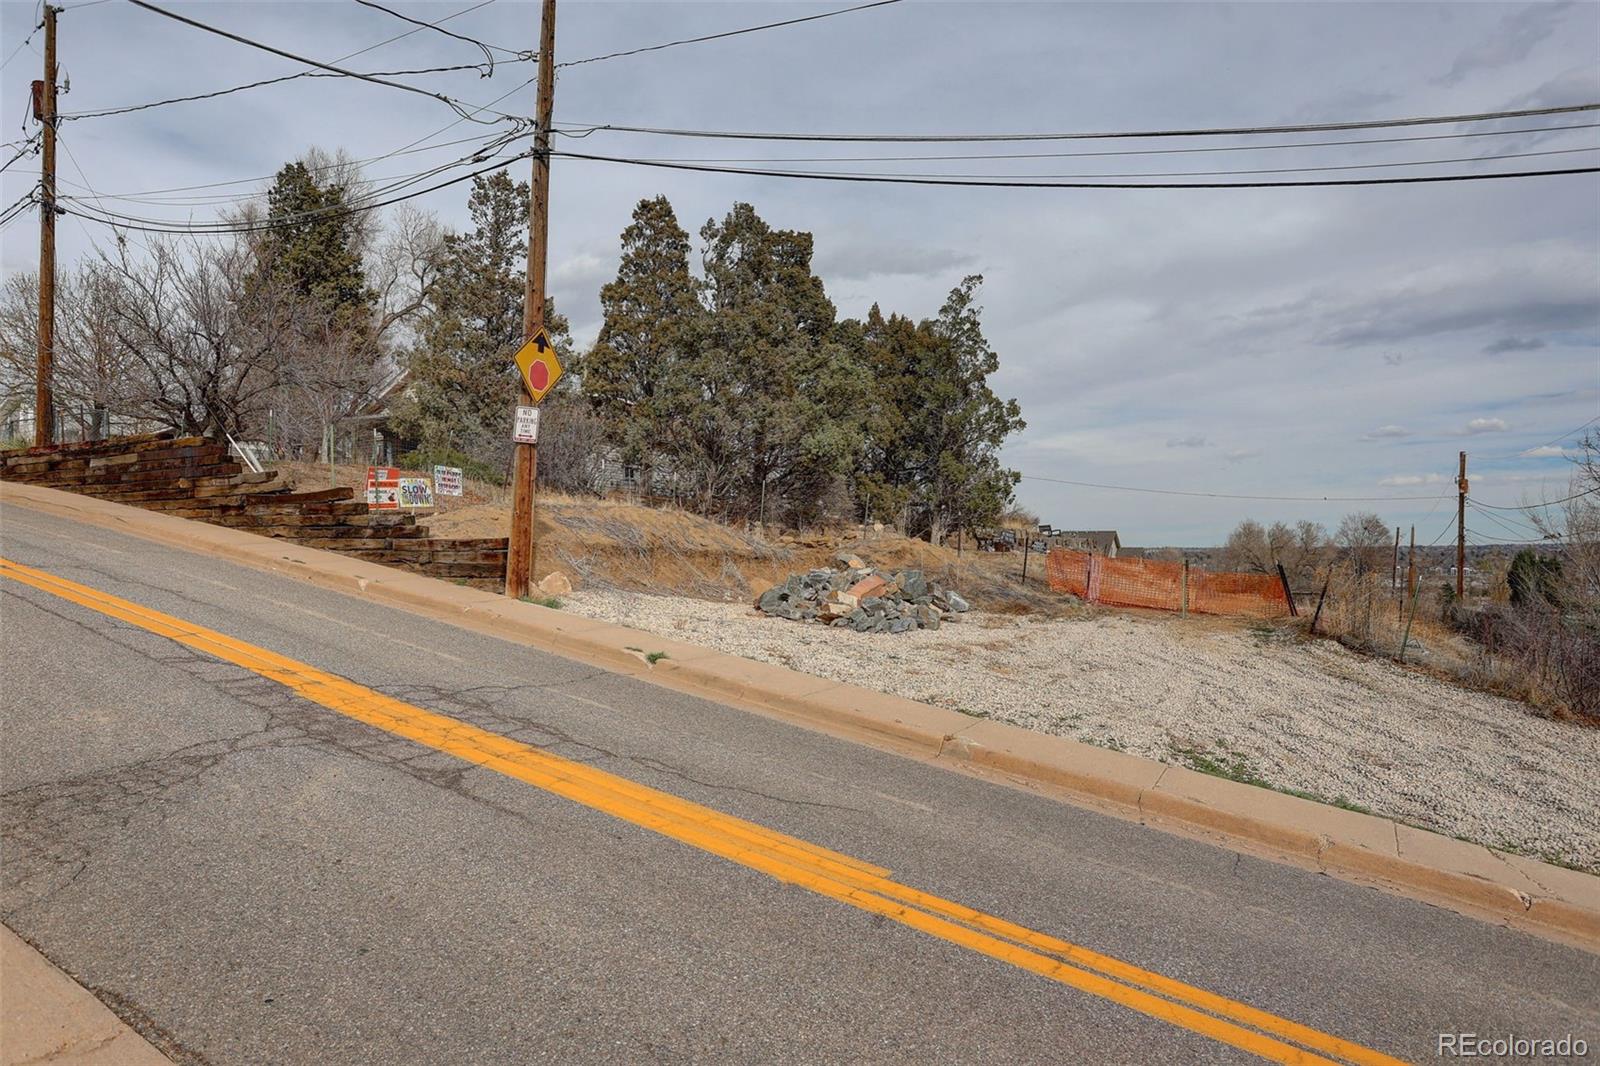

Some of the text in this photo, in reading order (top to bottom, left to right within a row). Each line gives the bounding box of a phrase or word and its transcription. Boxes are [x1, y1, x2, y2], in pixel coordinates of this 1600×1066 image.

[522, 409, 532, 417] NO
[517, 417, 537, 425] PARKING
[402, 485, 428, 494] SLOW
